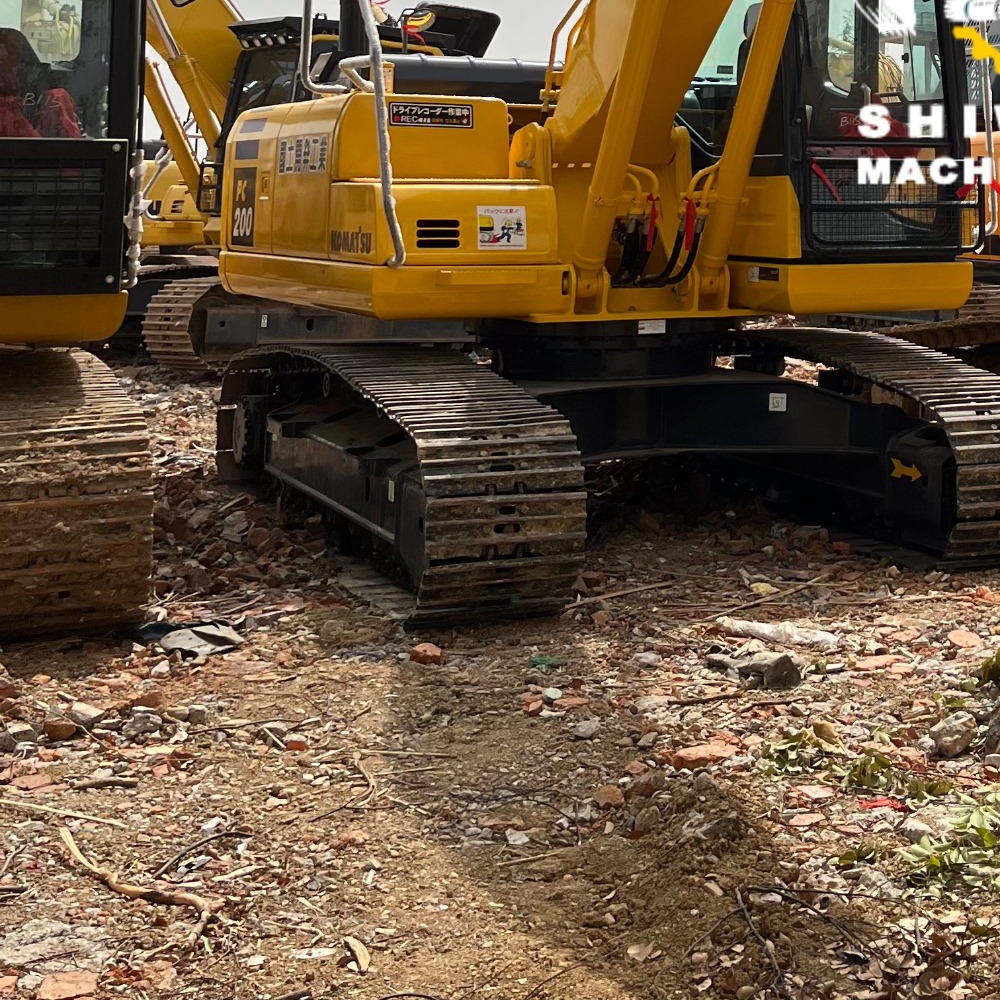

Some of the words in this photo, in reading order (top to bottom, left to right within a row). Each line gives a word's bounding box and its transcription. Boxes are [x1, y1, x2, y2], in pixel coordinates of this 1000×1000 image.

[400, 115, 418, 123] REC
[236, 180, 247, 202] PC
[232, 207, 253, 237] 200
[330, 226, 372, 254] KOMATSU
